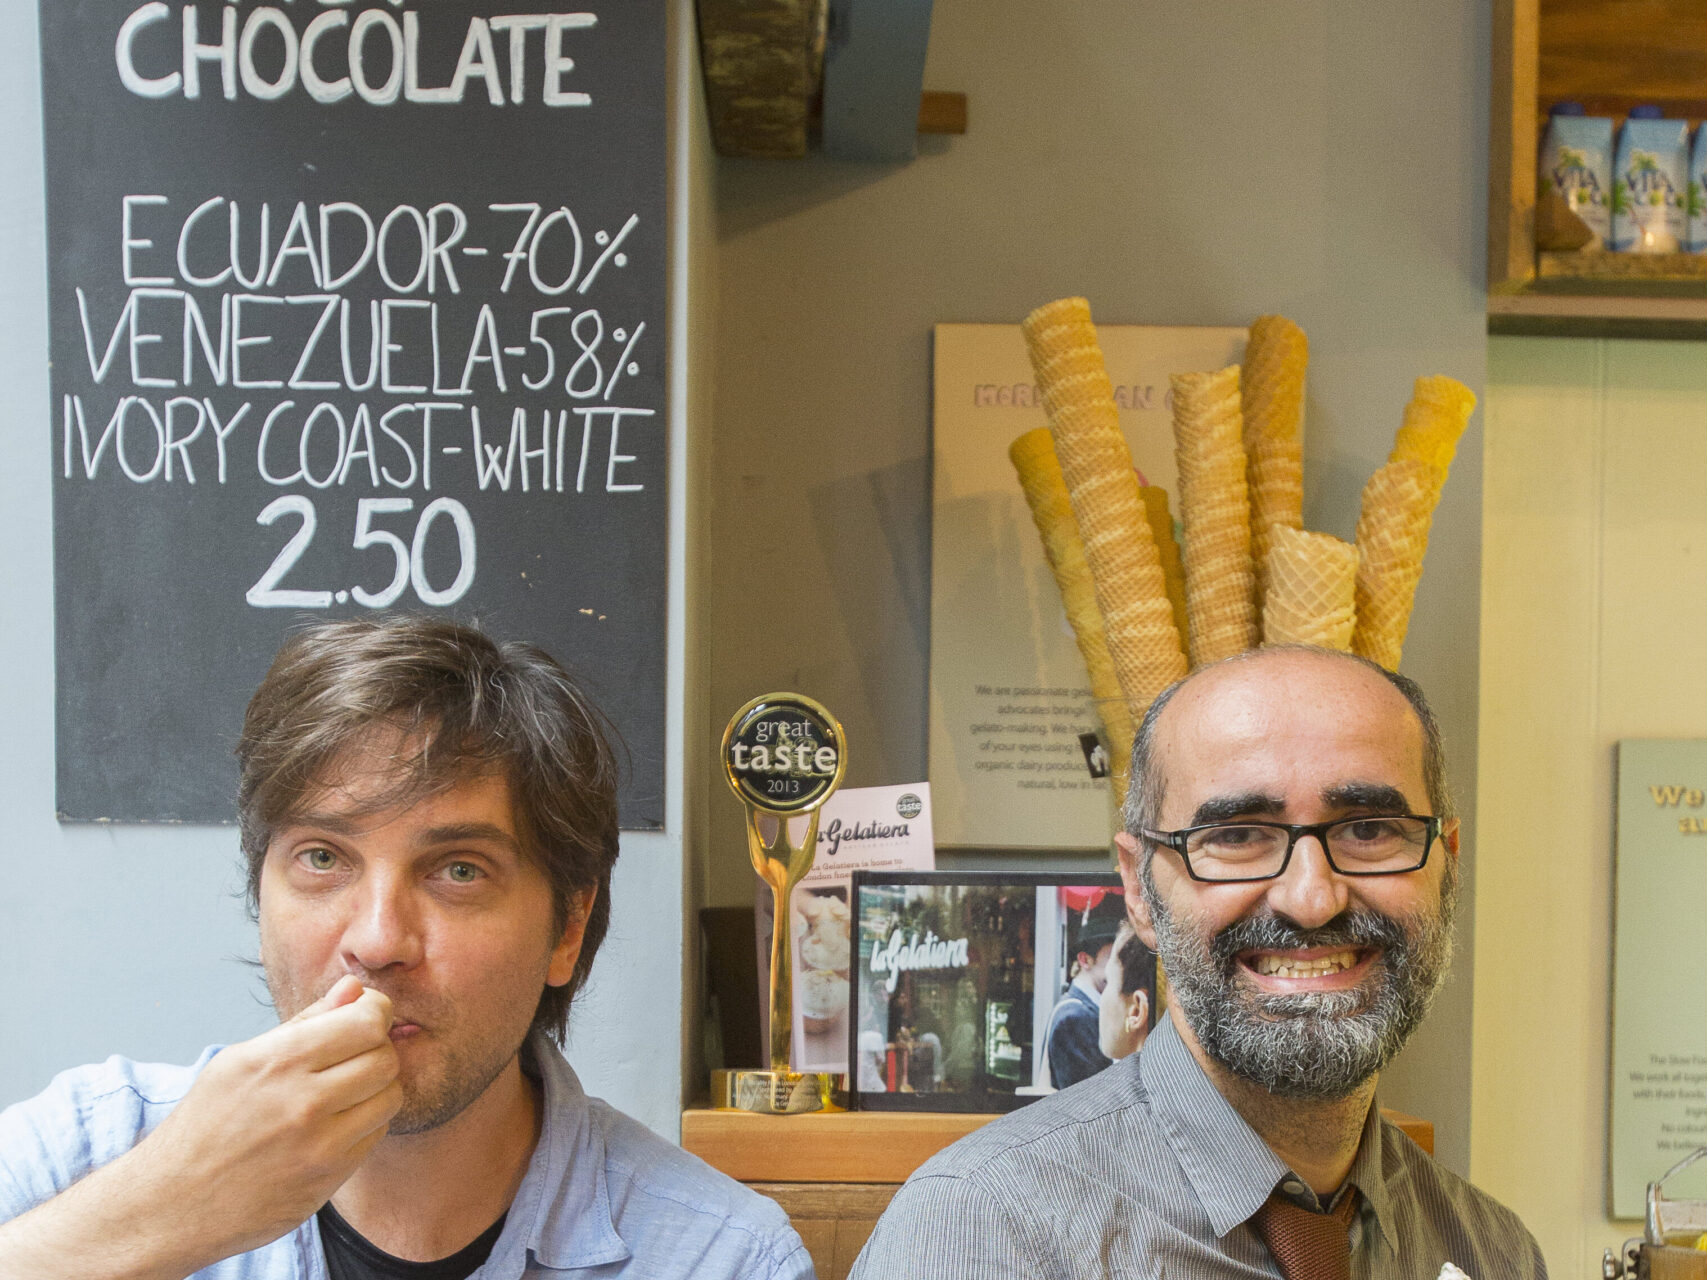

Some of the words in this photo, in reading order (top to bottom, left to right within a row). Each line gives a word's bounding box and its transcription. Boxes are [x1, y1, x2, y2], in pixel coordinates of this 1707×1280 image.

[115, 2, 597, 106] CHOCOLATE
[122, 194, 638, 294] ECUADOR-70%
[76, 287, 645, 400] VENEZUELA-58%
[63, 394, 251, 484] IVORY
[257, 401, 655, 492] COAST-WHITE
[246, 495, 476, 609] 2.50
[756, 719, 812, 742] great
[975, 685, 992, 695] We
[731, 741, 837, 772] taste
[767, 780, 799, 793] 2013
